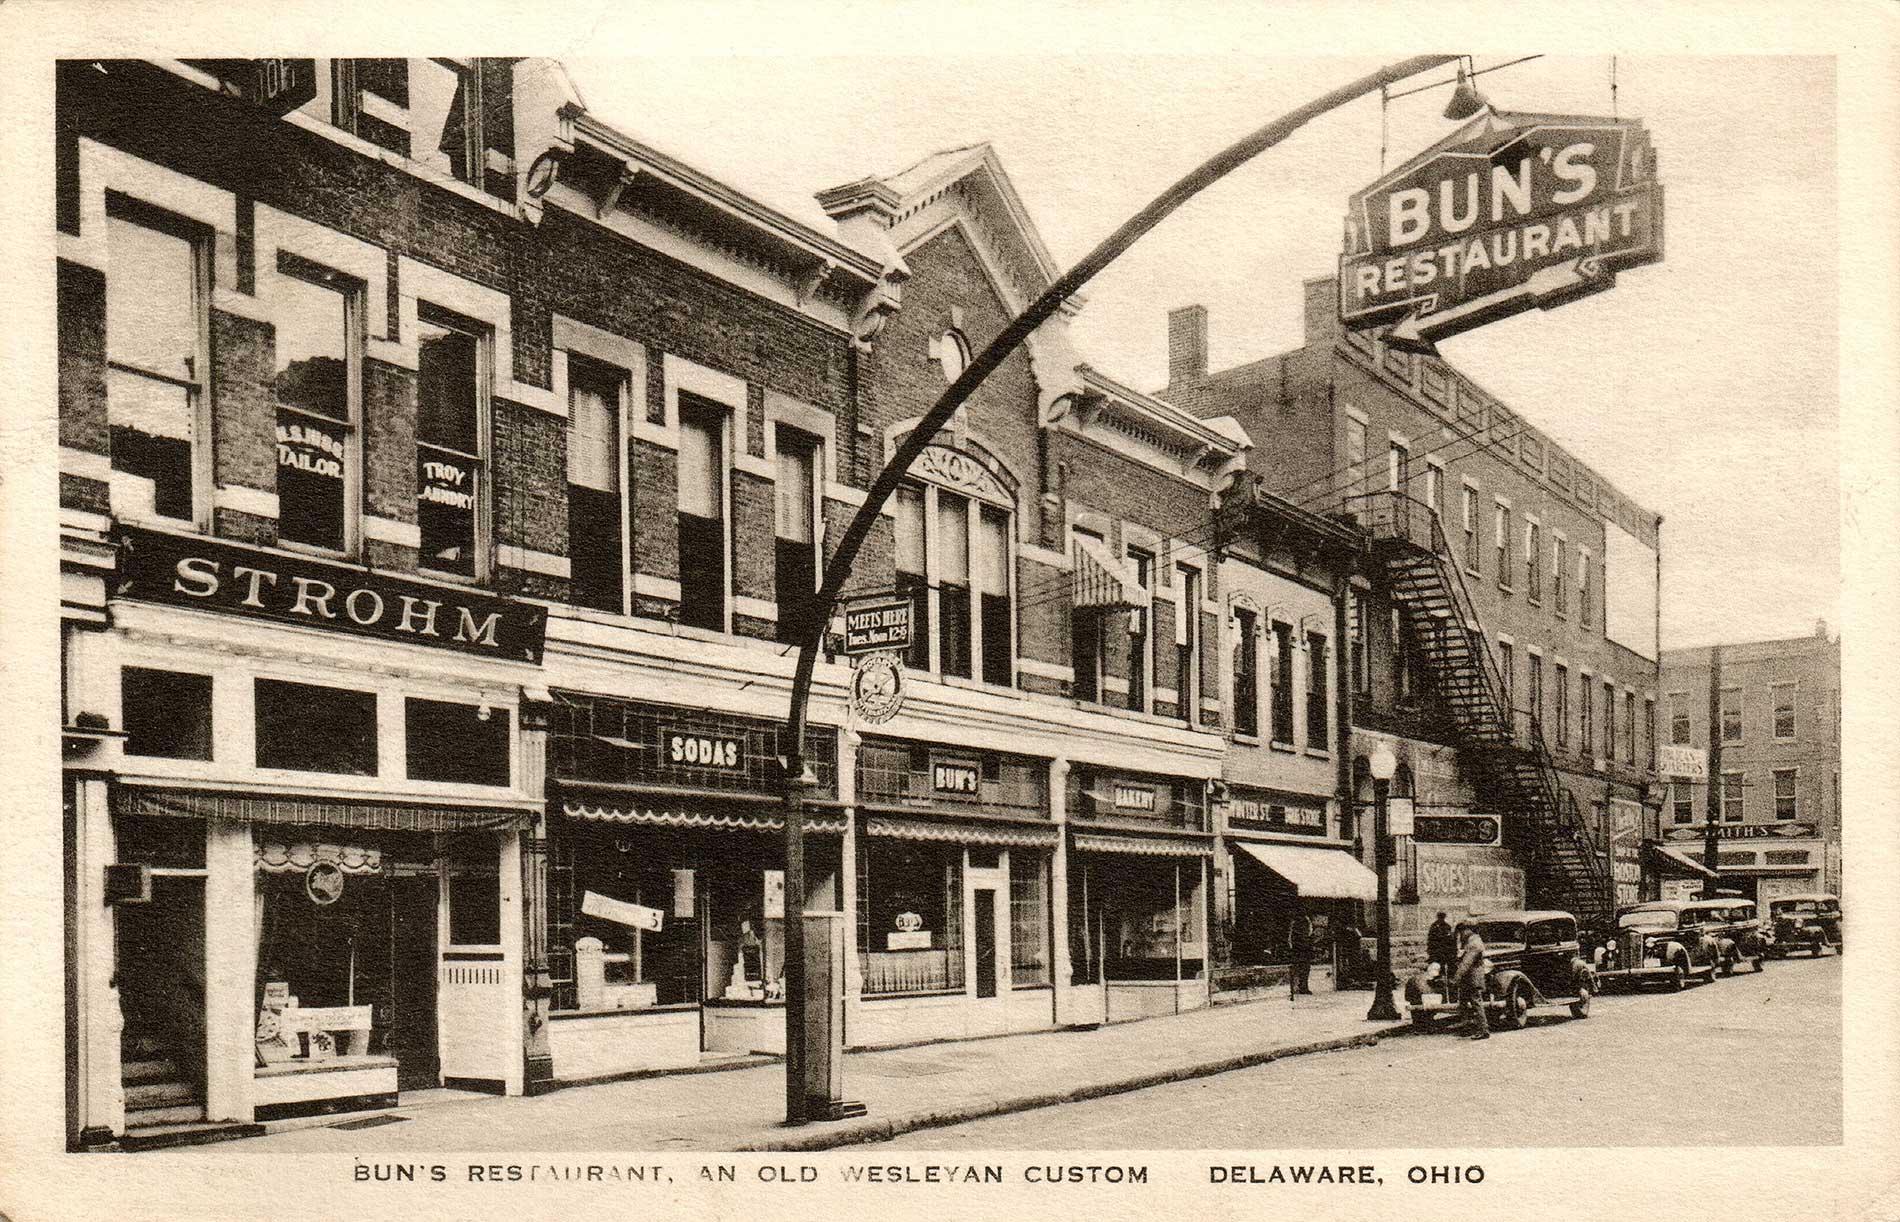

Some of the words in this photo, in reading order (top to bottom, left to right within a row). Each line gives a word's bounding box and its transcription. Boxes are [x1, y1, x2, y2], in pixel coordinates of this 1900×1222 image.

[1388, 142, 1599, 247] BUN'S
[1356, 202, 1639, 299] RESTAURANT
[422, 462, 466, 485] TROY
[417, 484, 475, 510] AUNDRY
[174, 557, 502, 648] STROHM
[848, 611, 881, 631] MEETS
[882, 607, 908, 627] HERE
[671, 736, 737, 767] SODAS
[936, 767, 977, 792] BUN'S
